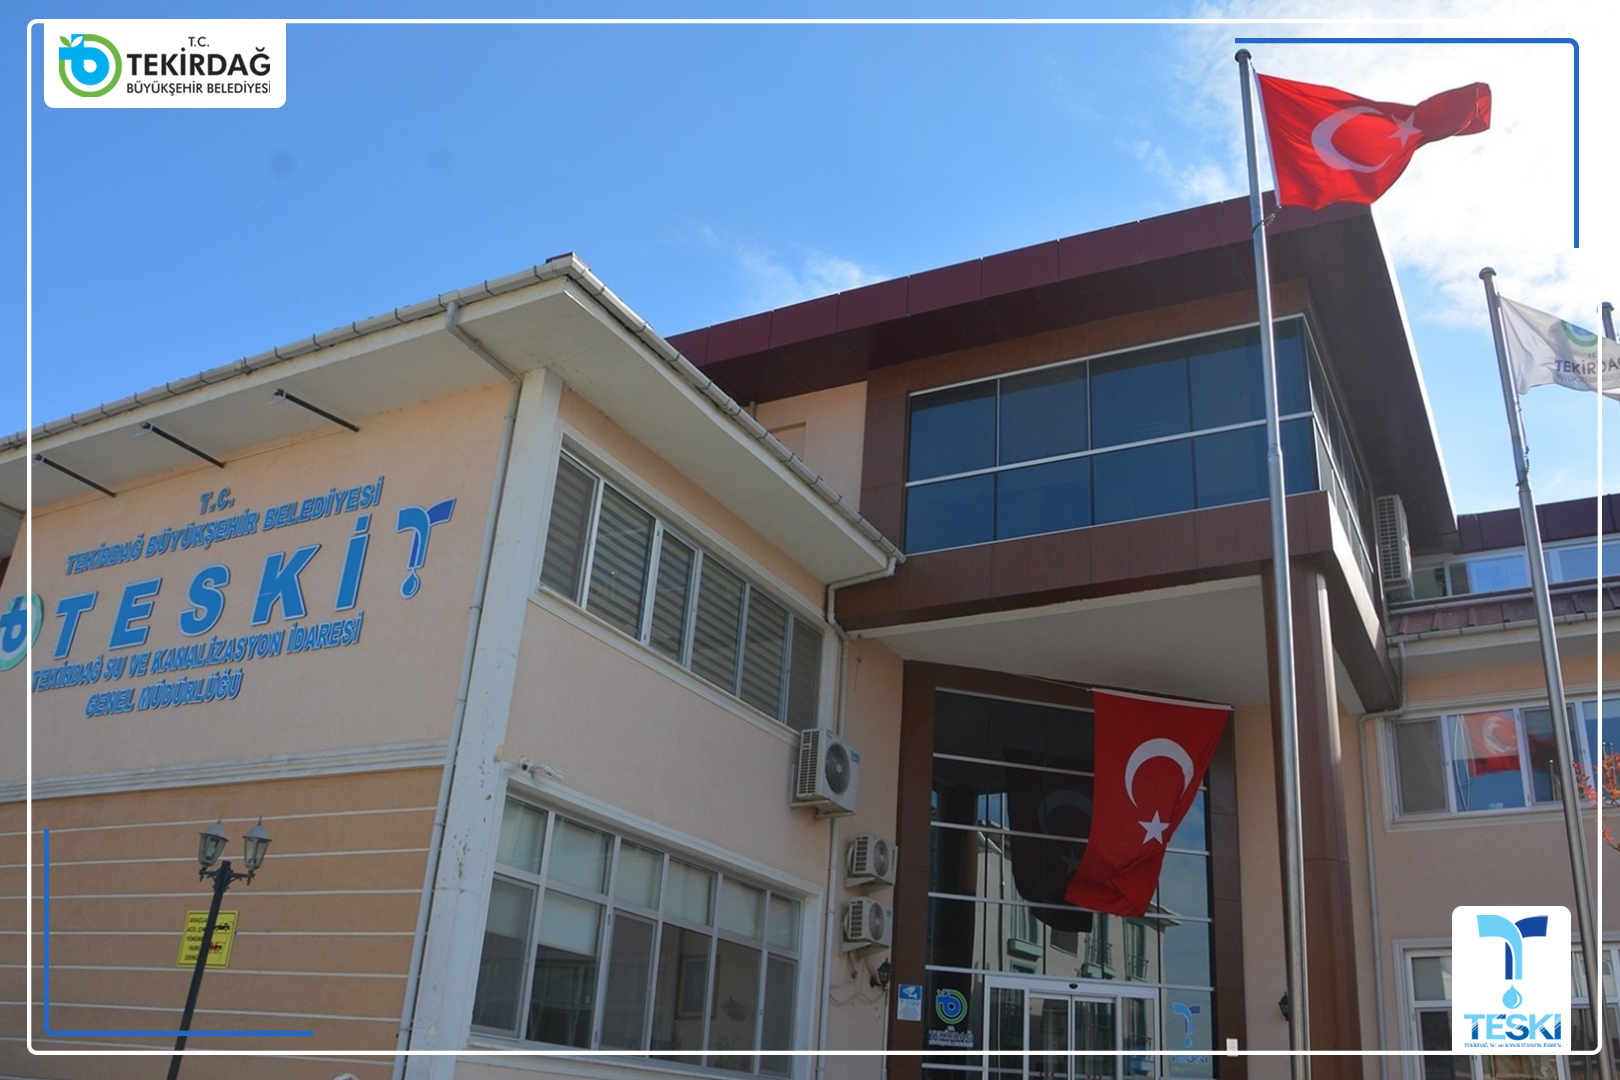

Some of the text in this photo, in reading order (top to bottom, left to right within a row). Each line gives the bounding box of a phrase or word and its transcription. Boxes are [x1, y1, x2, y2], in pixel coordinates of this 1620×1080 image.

[65, 475, 385, 575] TEKİRDAĞ BÜYÜKŞEHİR BELEDİYESİ
[200, 487, 236, 515] T.C.
[53, 513, 371, 660] TESKİ
[31, 611, 364, 693] TEKİRDAĞ SU VE KANALİZASYON İDARESİ
[84, 668, 244, 718] GENEL MÜDÜRLÜĞÜ
